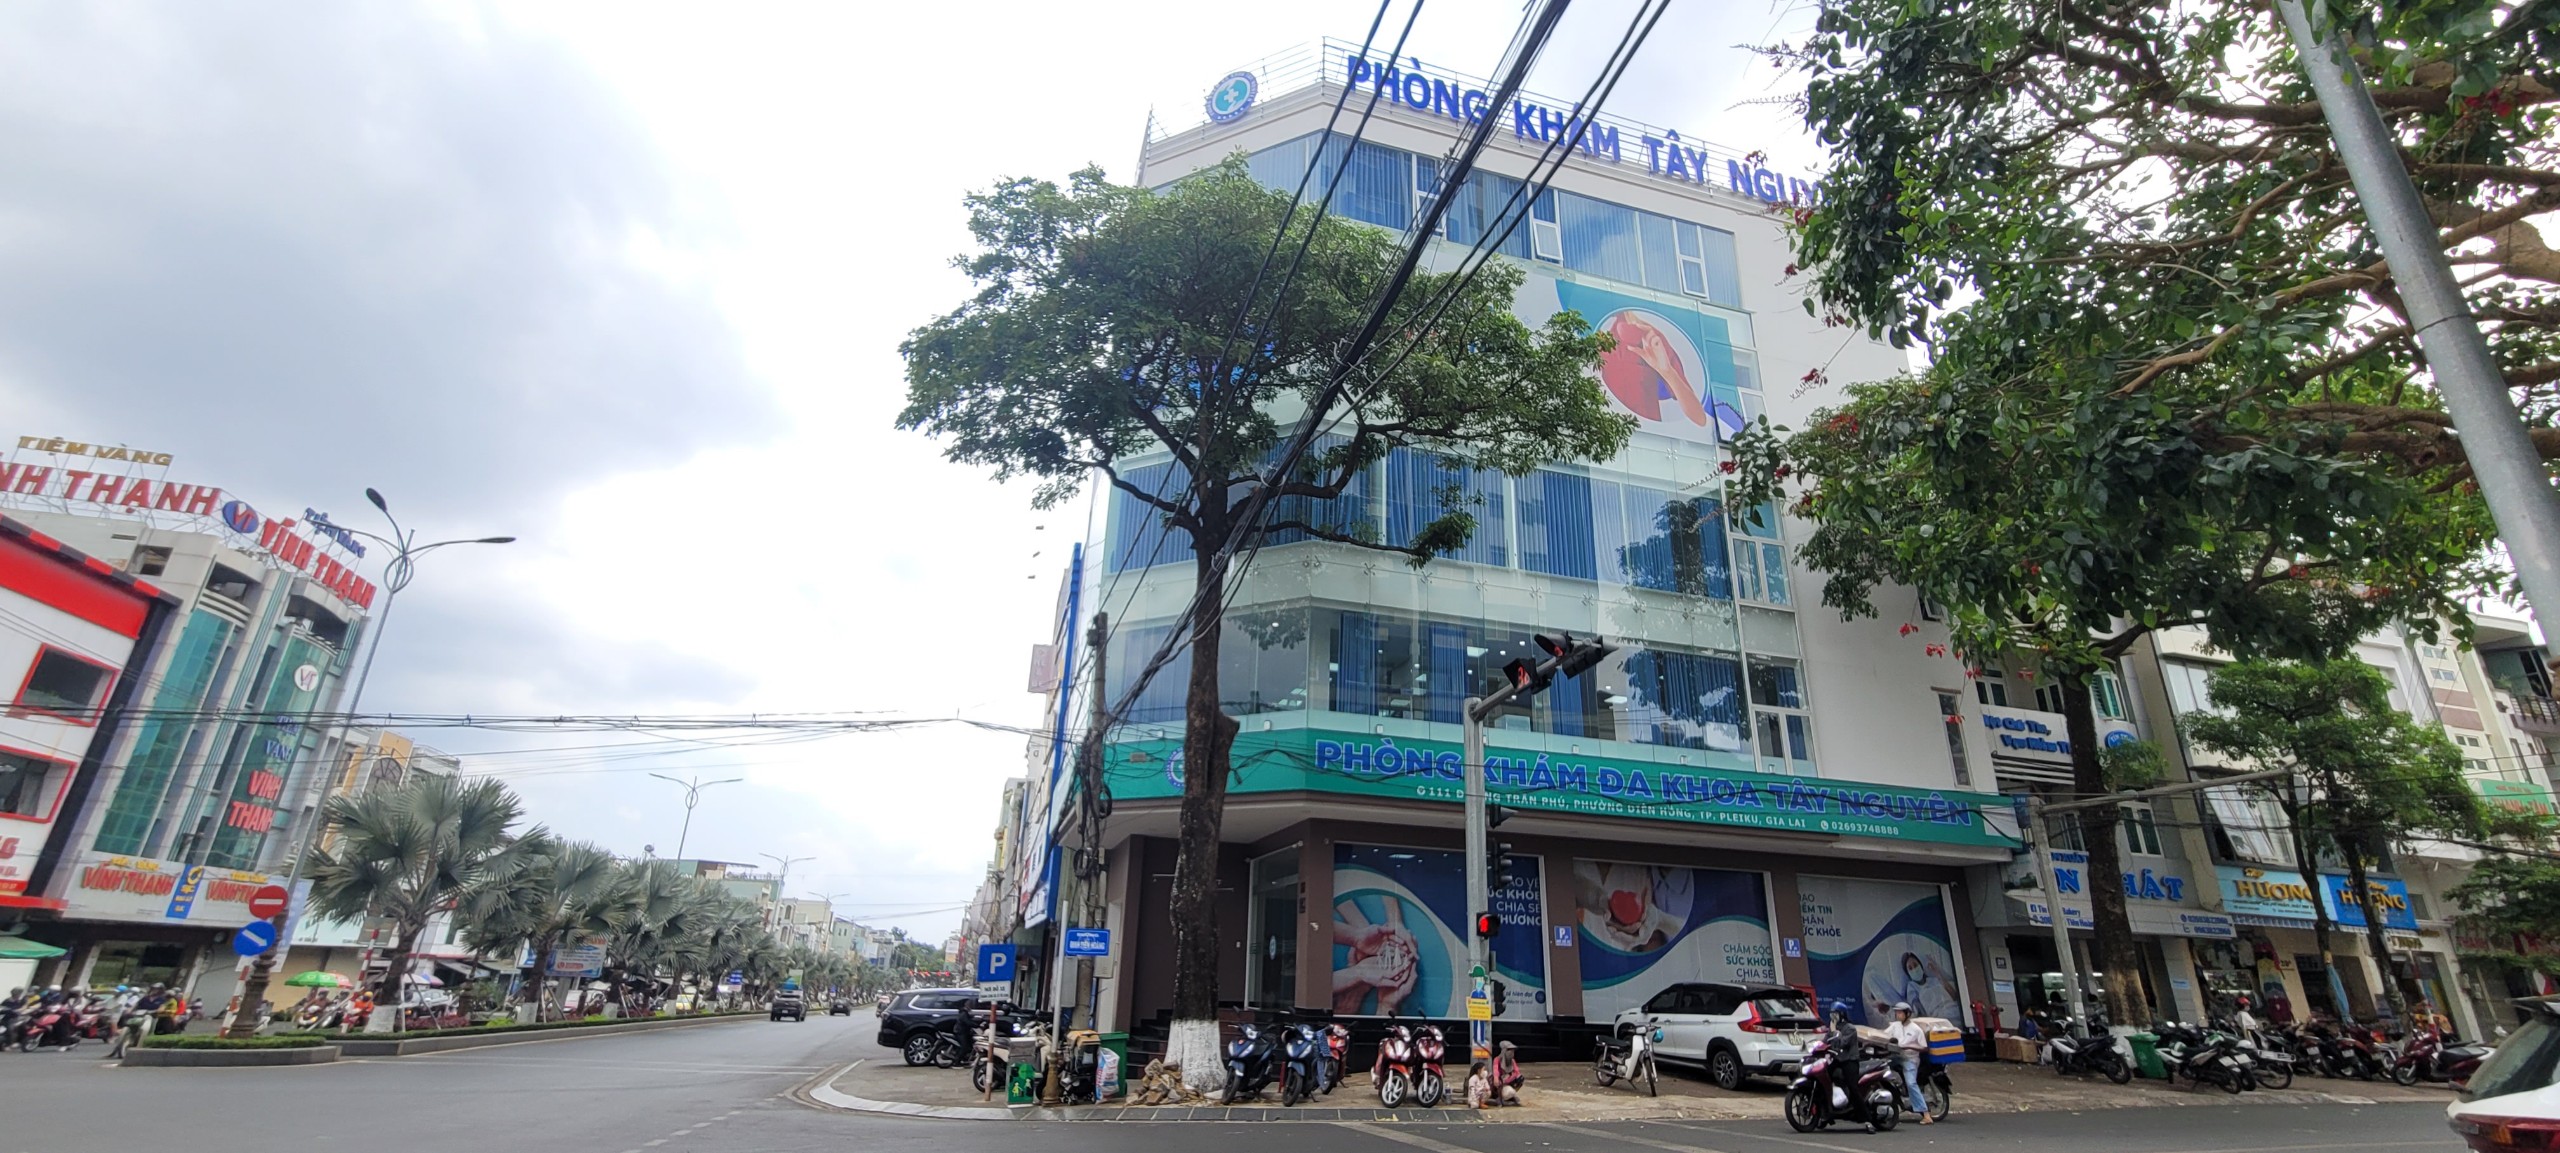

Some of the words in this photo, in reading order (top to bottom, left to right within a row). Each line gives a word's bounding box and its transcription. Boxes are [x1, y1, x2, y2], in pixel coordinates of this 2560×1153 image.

[1348, 55, 1494, 125] PHÒNG
[1514, 101, 1621, 163] KHÁM
[1641, 129, 1708, 185] TÂY
[1728, 159, 1826, 207] NGUY
[19, 436, 89, 456] TIỆM
[94, 442, 174, 466] VÀNG
[64, 470, 222, 514] THẠNH
[260, 517, 316, 571] VĨNH
[313, 552, 377, 610] THẠNH
[248, 768, 284, 800] VĨNH
[1315, 737, 1464, 781] PHÒNG
[1484, 752, 1589, 793] KHÁM
[1596, 765, 1655, 799] ĐA
[1660, 773, 1763, 808] KHOA
[1768, 778, 1830, 814] TÂY
[1837, 789, 1972, 826] NGUYÊN
[227, 800, 276, 835] THẠNH
[1429, 787, 1451, 798] 111
[1700, 810, 1716, 820] TP.
[1720, 813, 1762, 825] PLEIKU,
[1766, 816, 1785, 827] GIA
[1789, 818, 1806, 829] LAI
[81, 861, 125, 892] VĨNH
[124, 871, 177, 896] THẠNH
[1496, 901, 1526, 913] CHIA
[1817, 905, 1832, 914] TIN
[1560, 928, 1565, 939] P
[990, 952, 1007, 974] P
[1726, 954, 1744, 965] SỨC
[1736, 968, 1760, 978] CHIA
